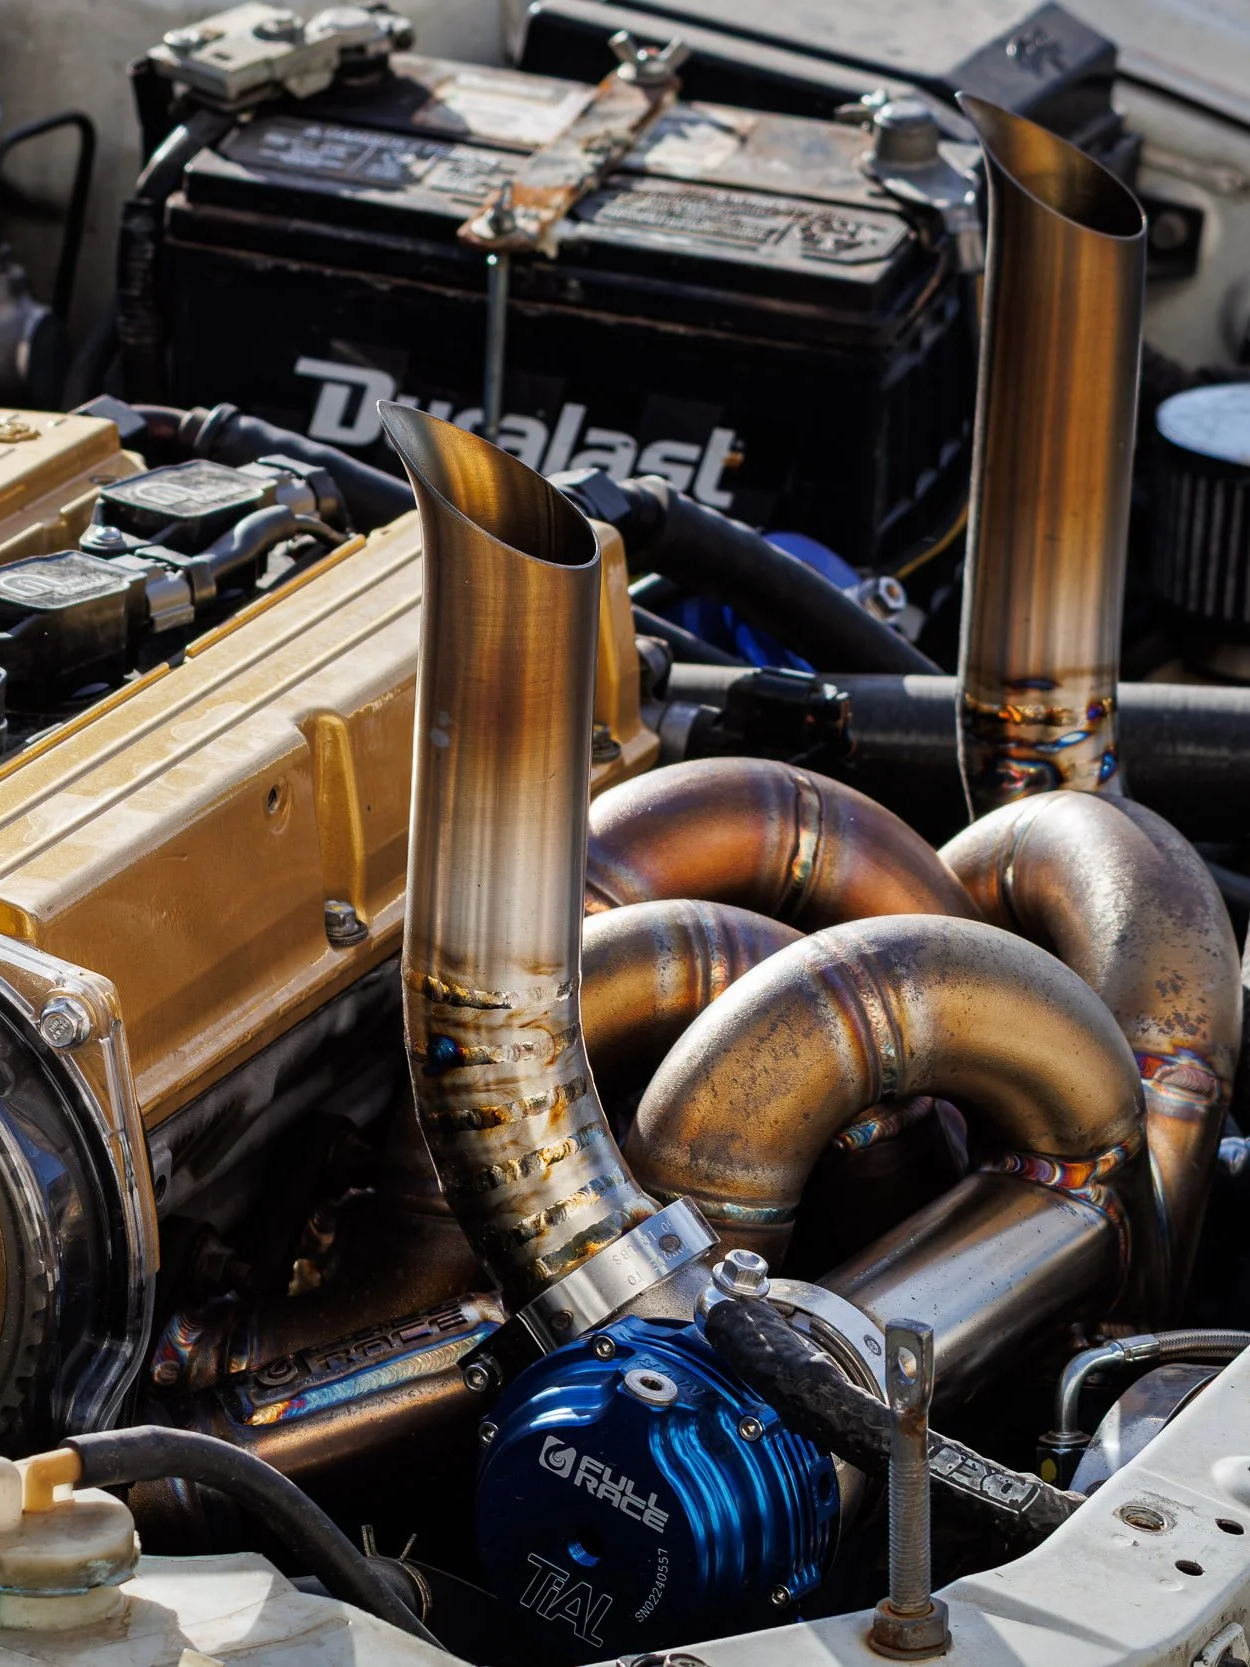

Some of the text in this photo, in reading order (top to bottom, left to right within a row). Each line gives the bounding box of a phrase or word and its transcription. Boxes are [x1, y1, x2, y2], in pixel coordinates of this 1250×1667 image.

[573, 1468, 669, 1534] RACE
[578, 1455, 669, 1519] FULL
[519, 1553, 613, 1648] TiAL
